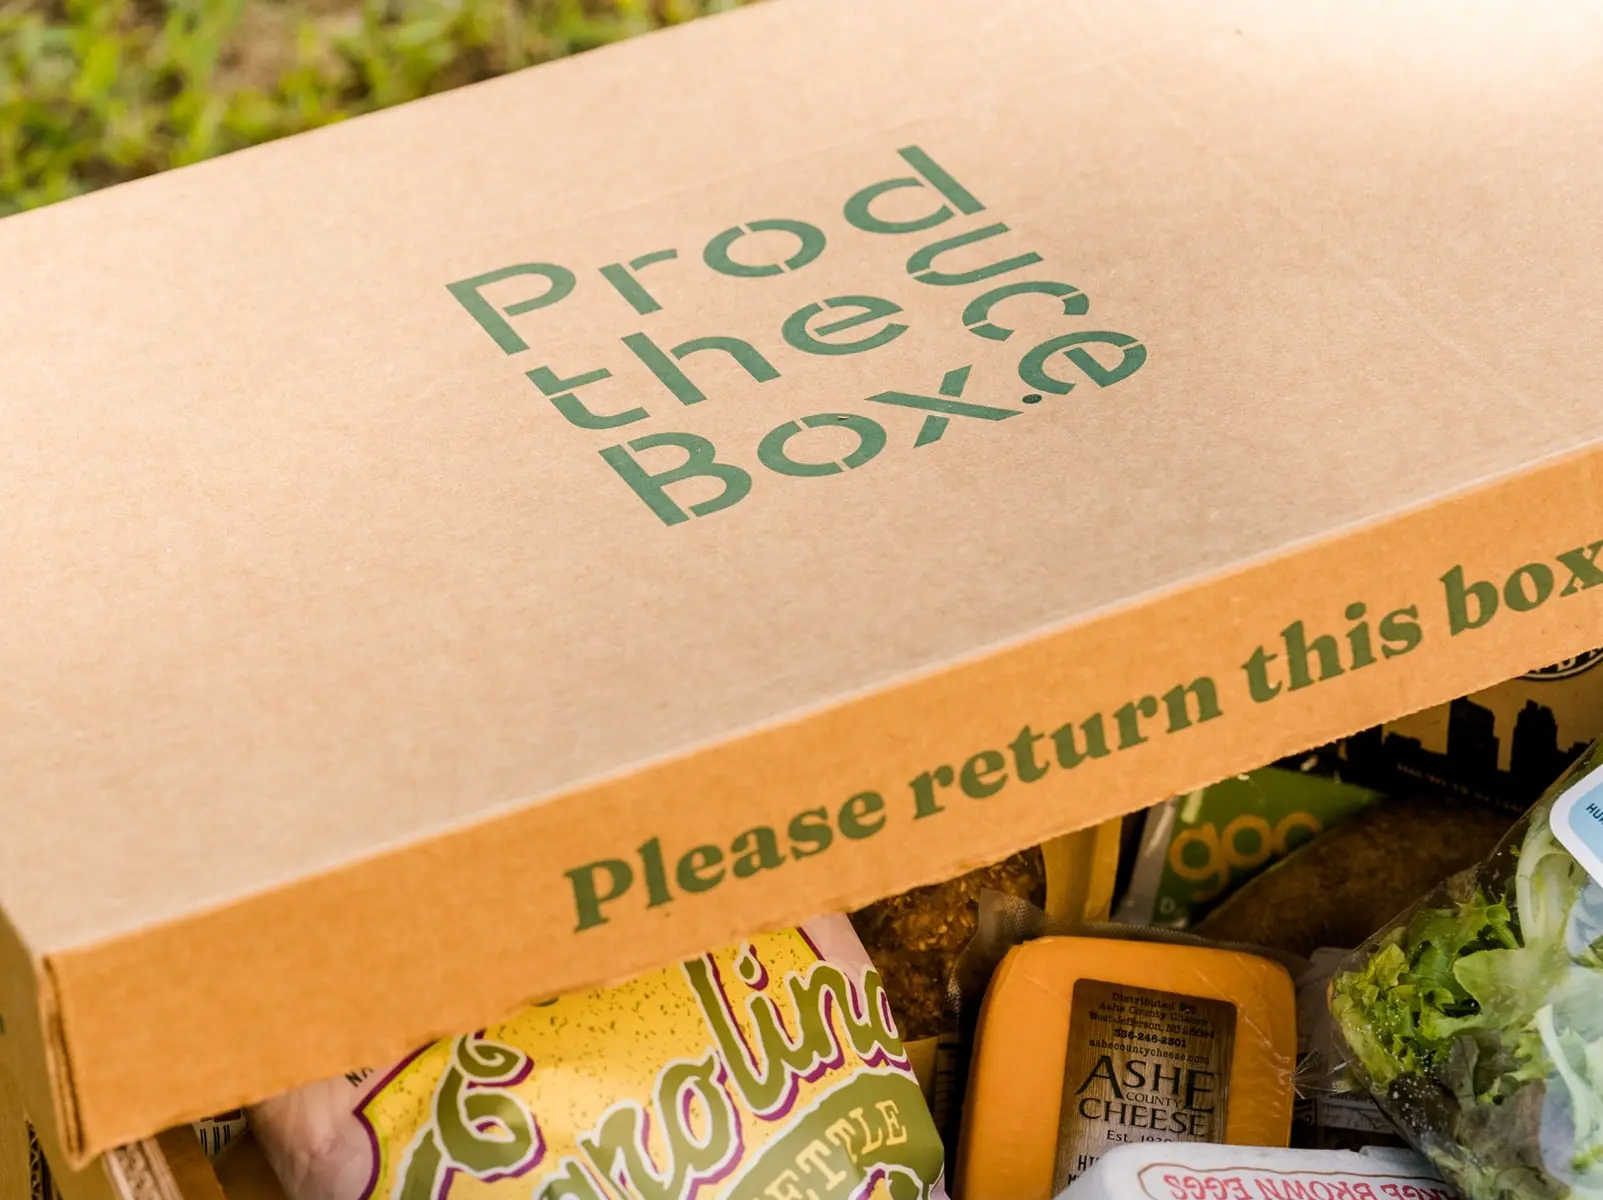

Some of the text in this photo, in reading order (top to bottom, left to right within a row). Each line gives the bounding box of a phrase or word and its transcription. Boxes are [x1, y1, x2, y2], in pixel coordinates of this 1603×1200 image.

[525, 294, 909, 431] the
[563, 538, 1603, 933] Please return this box
[1098, 1002, 1126, 1013] Ashe
[1128, 1005, 1167, 1019] County
[1112, 992, 1175, 1011] Distributed
[1089, 1038, 1210, 1065] ashecountycheese.com
[1074, 1054, 1216, 1114] ASHE
[1126, 1091, 1182, 1108] COUNTY
[1078, 1097, 1206, 1138] CHEESE
[1106, 1129, 1133, 1143] Est.
